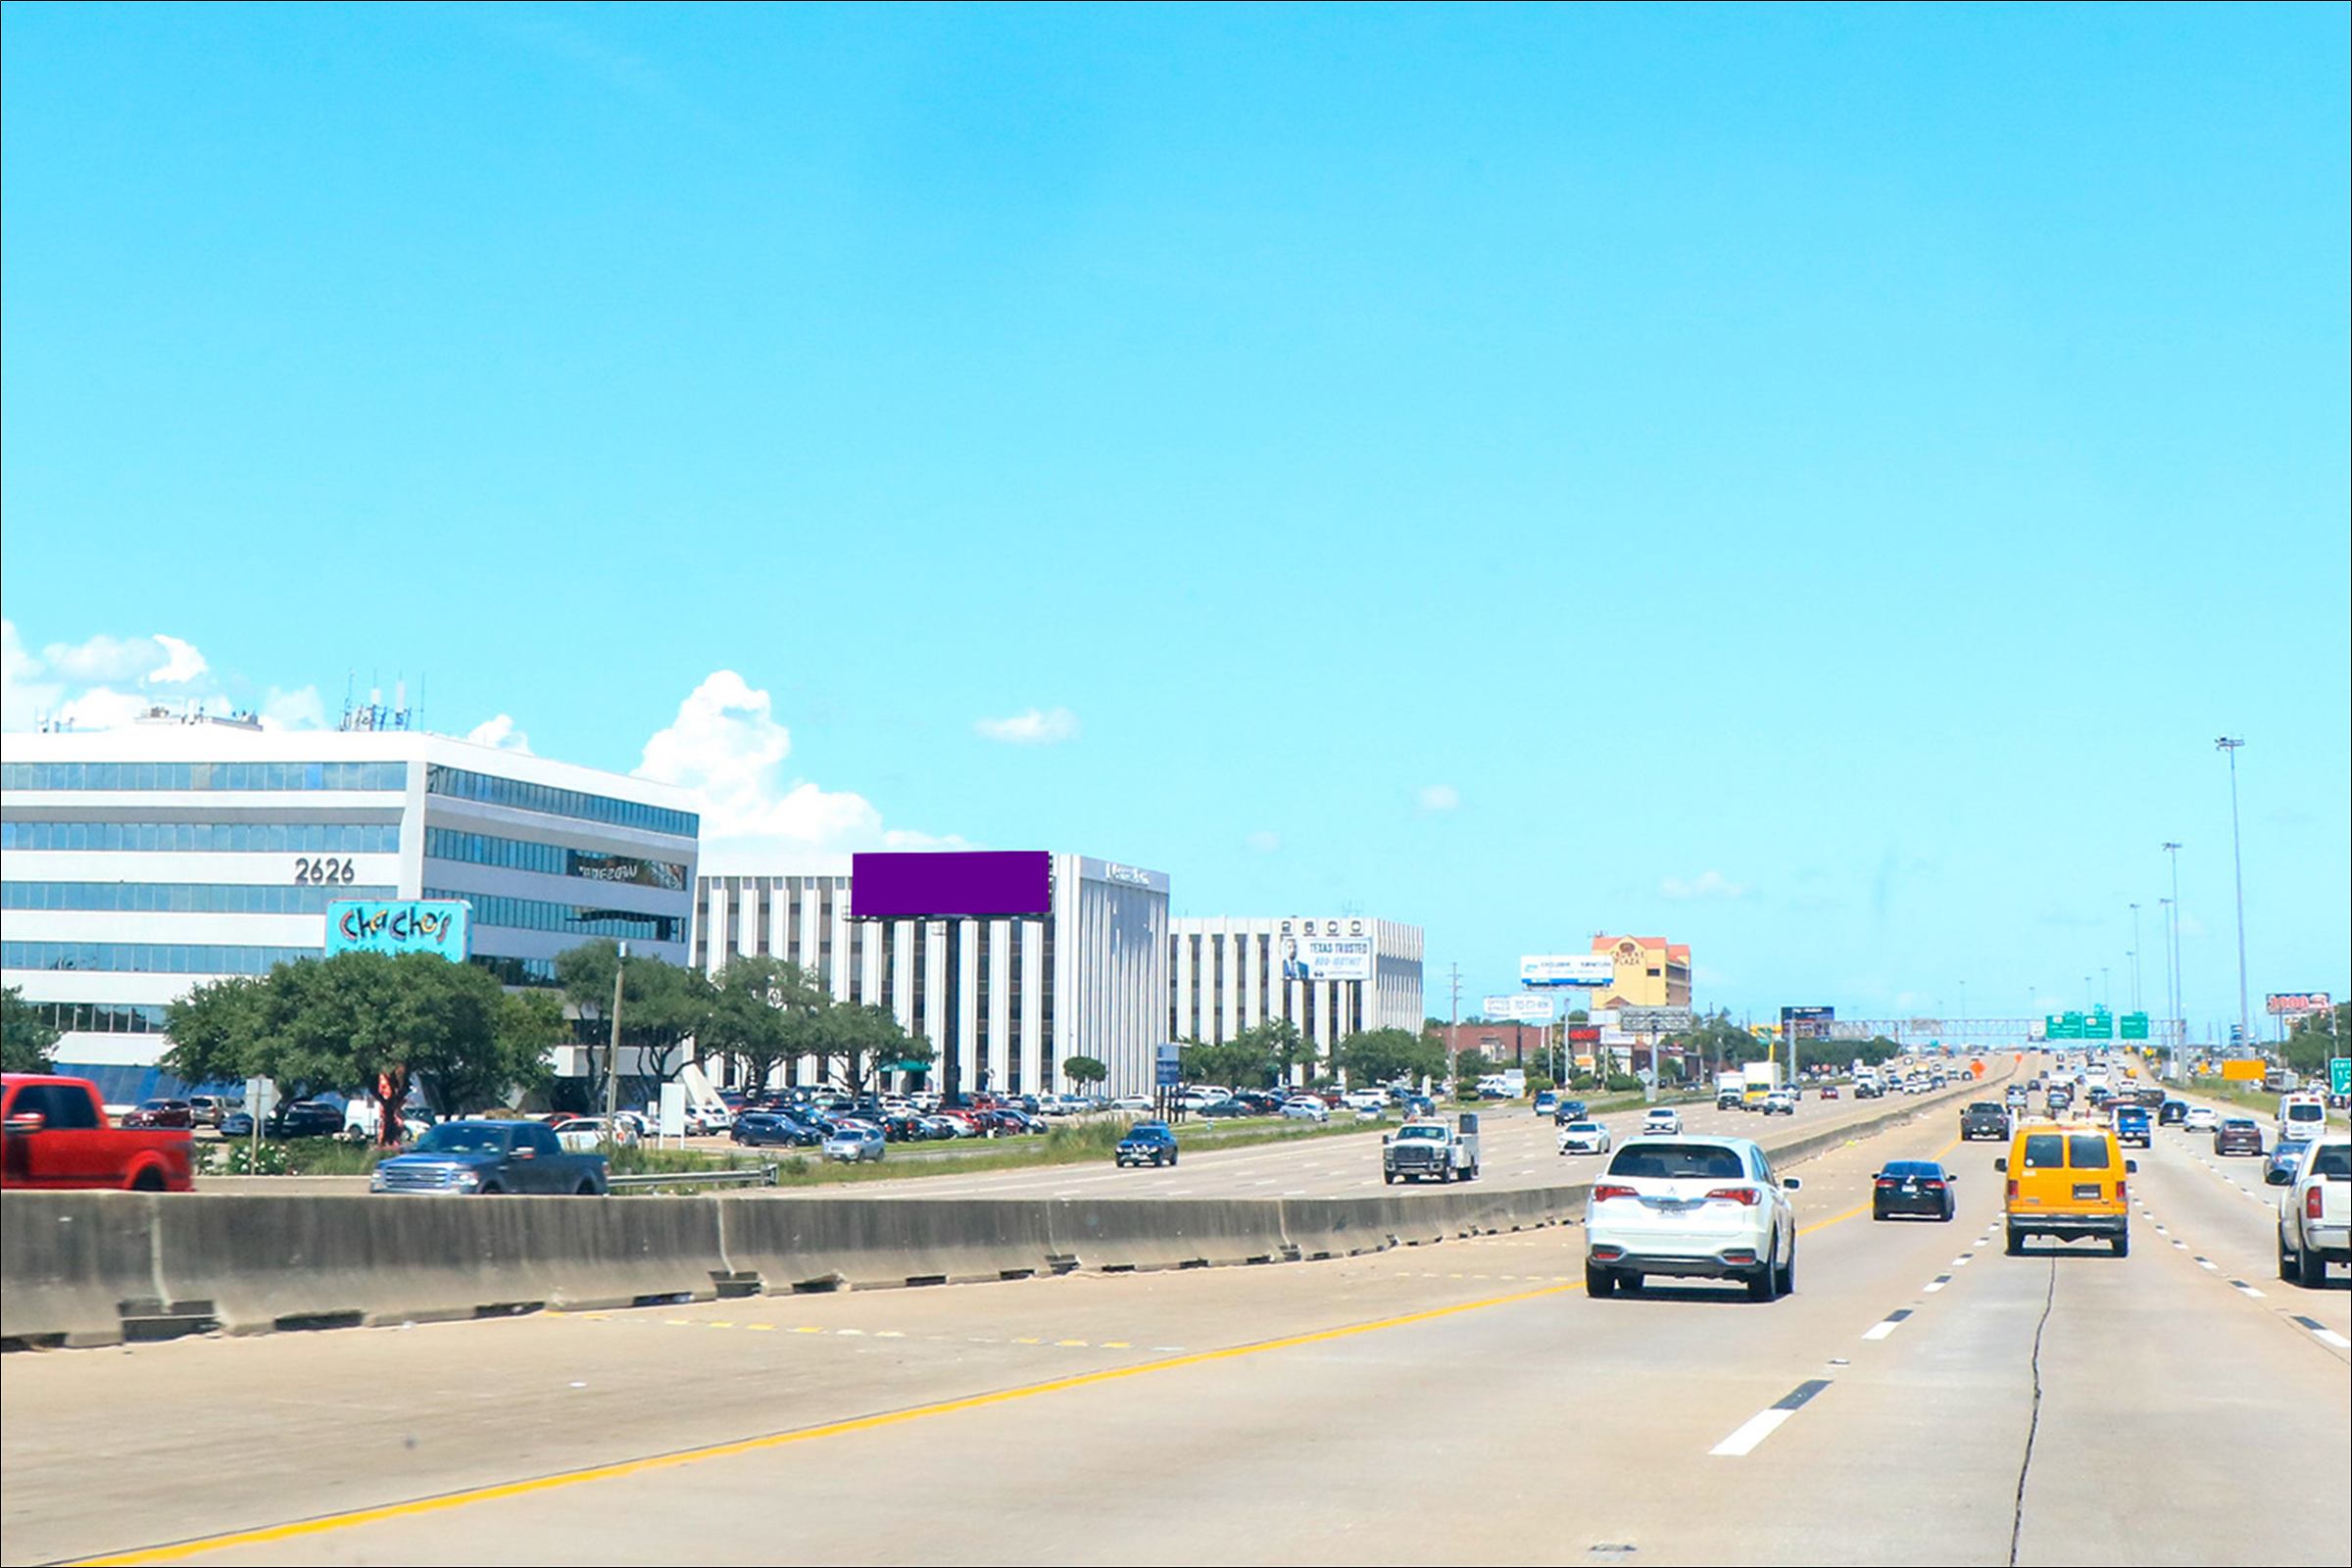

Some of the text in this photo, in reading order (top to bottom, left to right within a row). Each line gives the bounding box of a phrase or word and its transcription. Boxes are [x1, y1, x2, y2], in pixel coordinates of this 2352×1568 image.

[295, 858, 355, 884] 2626
[1309, 943, 1367, 955] TEXAS TRUSTED
